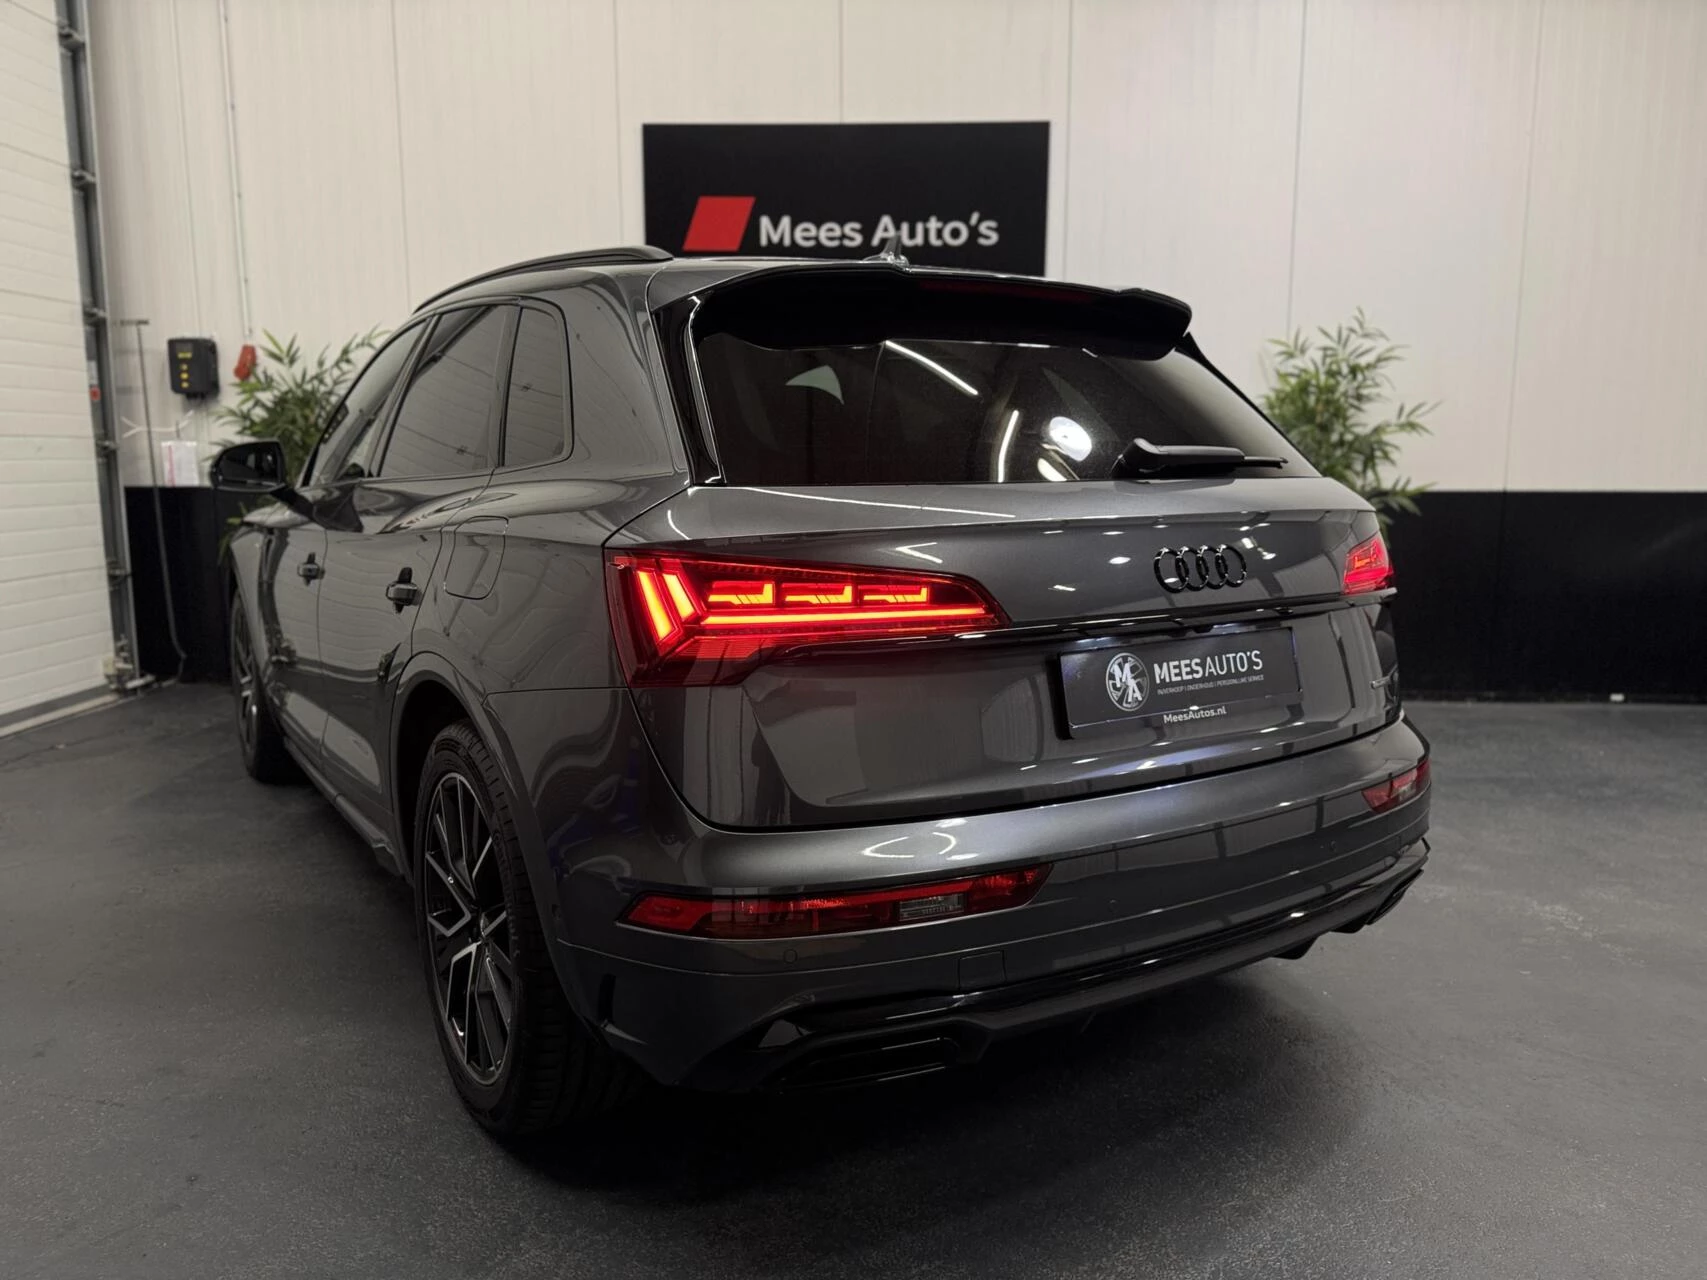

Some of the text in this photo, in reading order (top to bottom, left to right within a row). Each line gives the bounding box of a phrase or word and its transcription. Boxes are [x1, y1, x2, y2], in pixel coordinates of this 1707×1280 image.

[758, 211, 1000, 247] Mees Auto's
[1163, 706, 1227, 724] MeesAutos.nl
